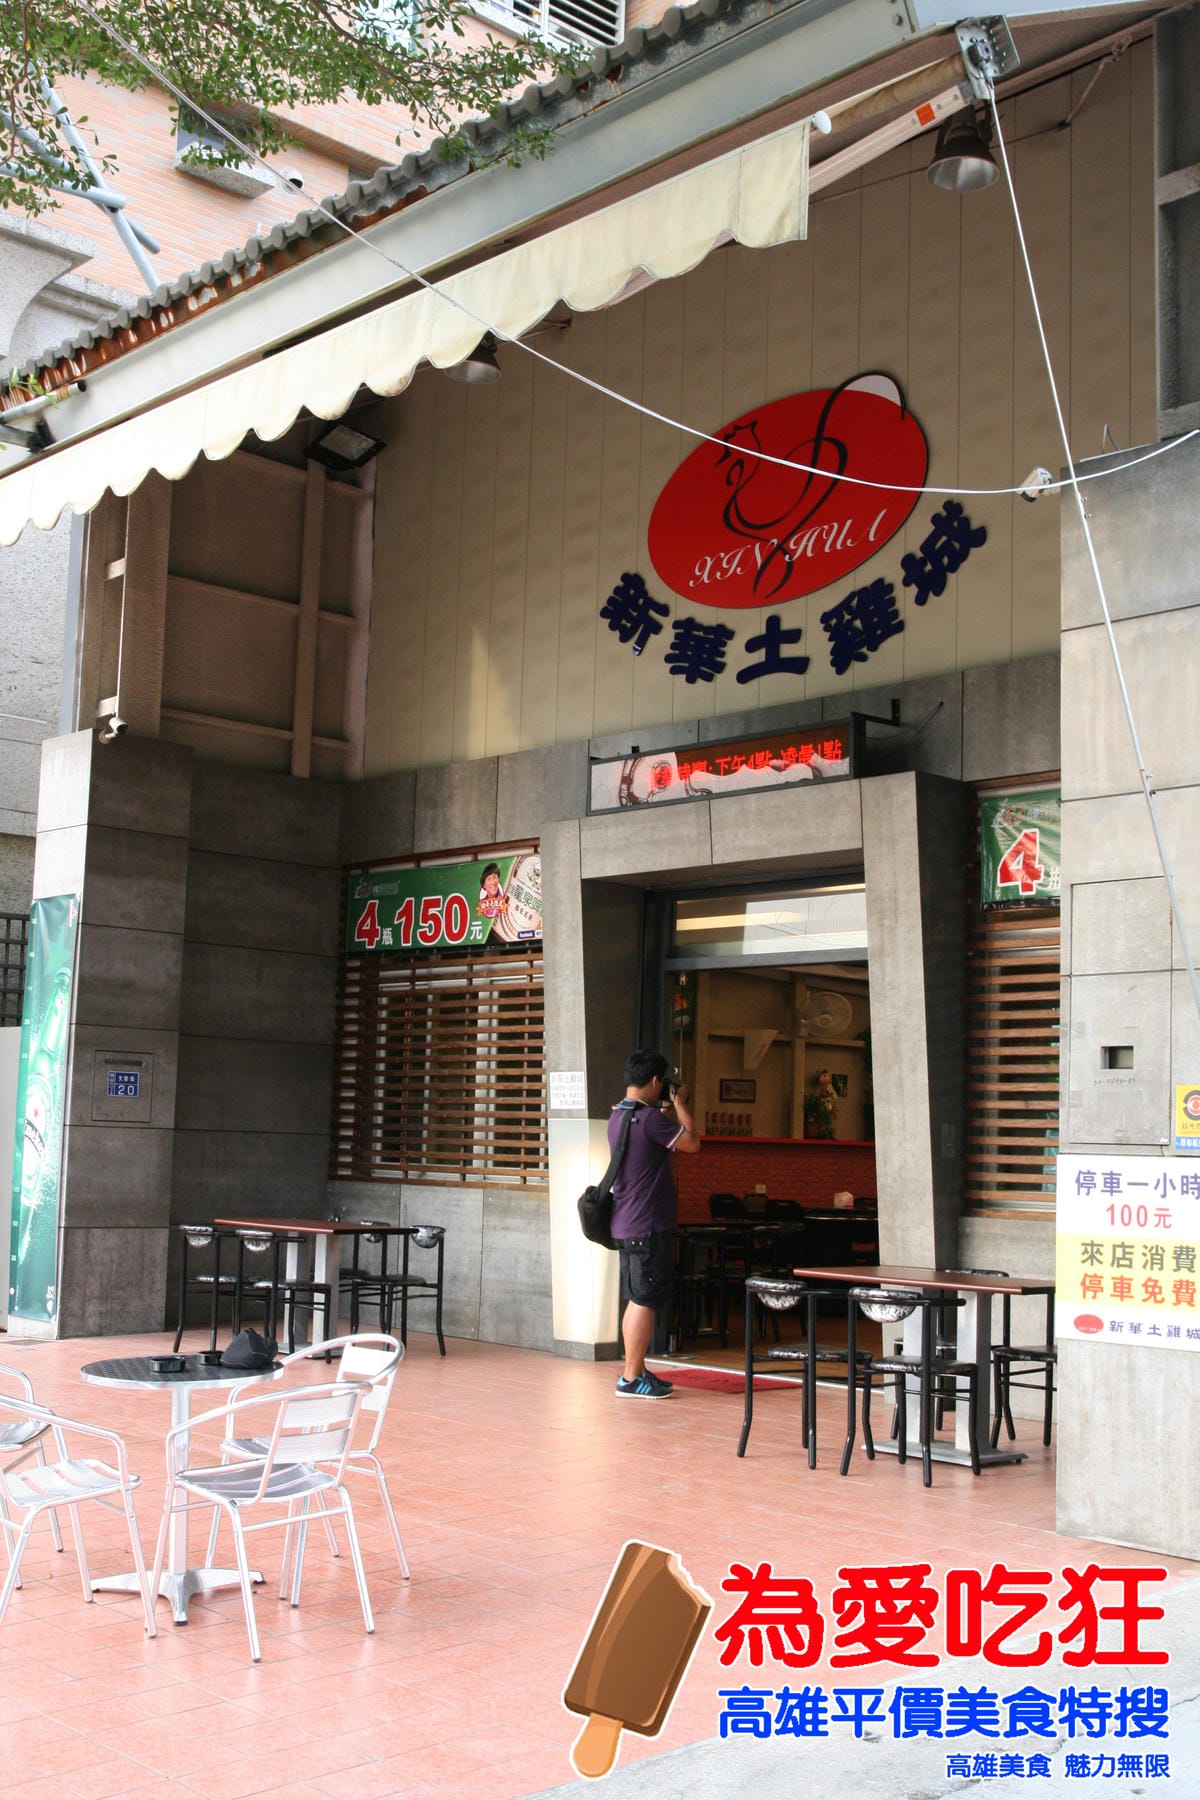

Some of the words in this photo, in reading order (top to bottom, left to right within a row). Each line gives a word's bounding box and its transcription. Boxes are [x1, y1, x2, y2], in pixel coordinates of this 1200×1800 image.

[600, 500, 987, 685] 新華土雞城
[118, 1085, 135, 1096] 20
[1075, 1169, 1200, 1200] 停車一小時
[1106, 1203, 1173, 1229] 100元
[1080, 1240, 1197, 1274] 來店消費
[1080, 1273, 1197, 1307] 停車免費
[1109, 1320, 1200, 1340] 新華土雞城
